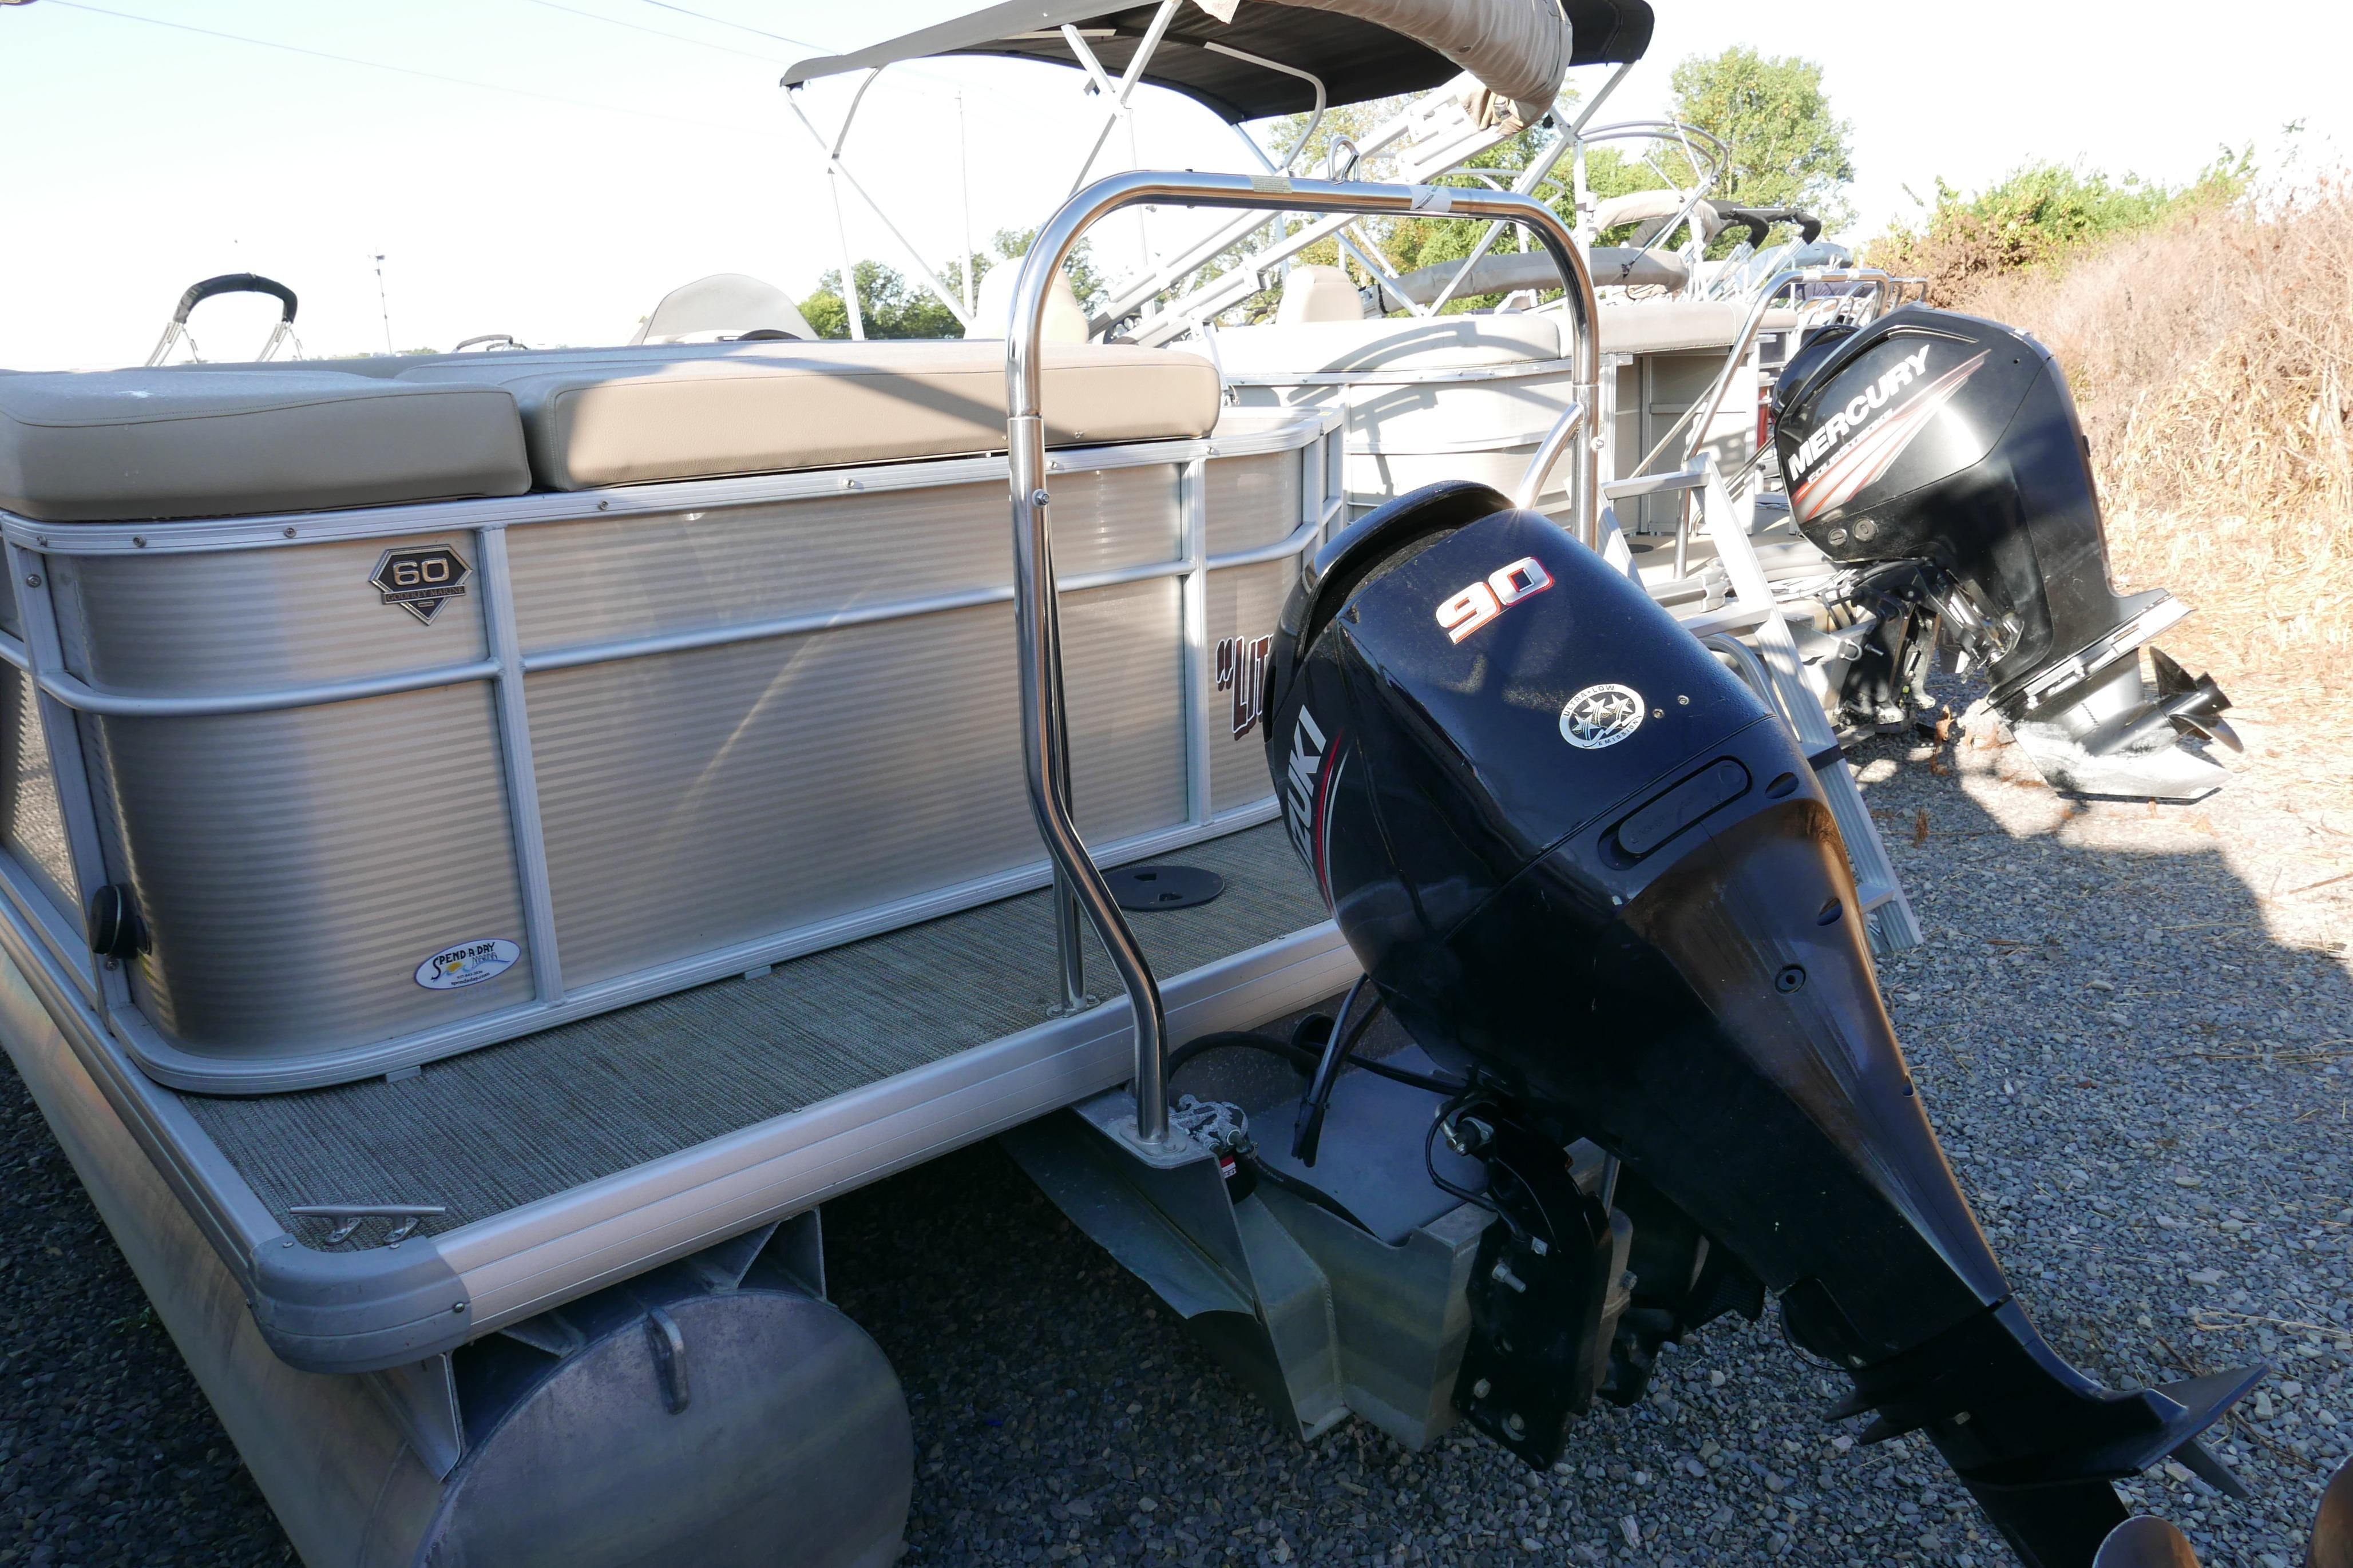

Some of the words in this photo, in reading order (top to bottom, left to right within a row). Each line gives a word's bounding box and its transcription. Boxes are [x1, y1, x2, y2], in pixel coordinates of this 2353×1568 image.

[1788, 344, 1930, 481] MERCURY
[393, 557, 449, 586] 60
[387, 590, 430, 602] GODFREY
[430, 586, 464, 597] MARINE
[1436, 553, 1555, 645] 90
[1598, 720, 1639, 746] EMISSION
